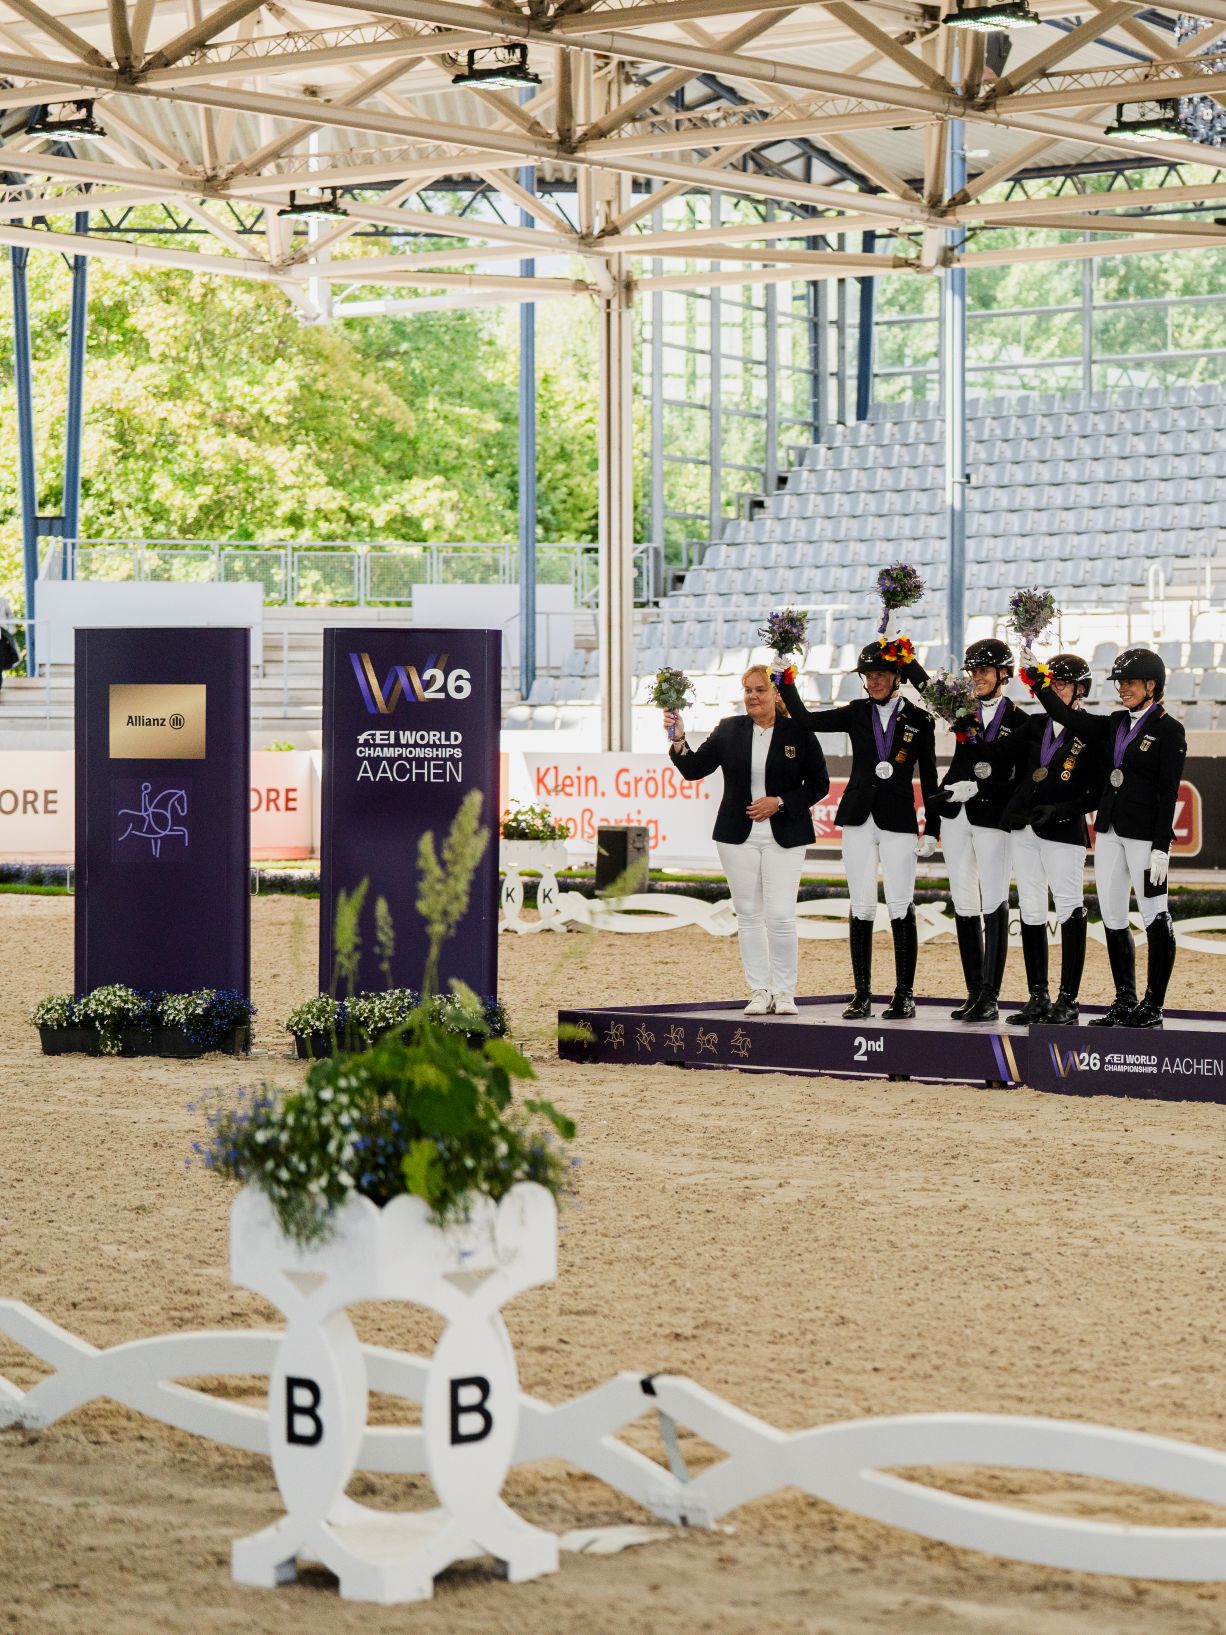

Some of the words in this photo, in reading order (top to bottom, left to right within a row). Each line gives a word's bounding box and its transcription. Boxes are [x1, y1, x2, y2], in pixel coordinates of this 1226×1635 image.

[126, 715, 167, 728] Allianz
[356, 731, 396, 744] FEI
[399, 731, 463, 745] WORLD
[356, 747, 463, 759] CHAMPIONSHIPS
[356, 760, 463, 783] AACHEN
[535, 765, 606, 798] Klein.
[614, 766, 710, 800] Größer.
[505, 887, 516, 904] K
[542, 887, 553, 905] K
[853, 1036, 884, 1062] 2nd
[1104, 1064, 1158, 1074] CHAMPIONSHIPS
[1126, 1054, 1158, 1066] WORLD
[1161, 1057, 1224, 1077] AACHEN
[285, 1375, 324, 1448] B
[449, 1375, 493, 1446] B
